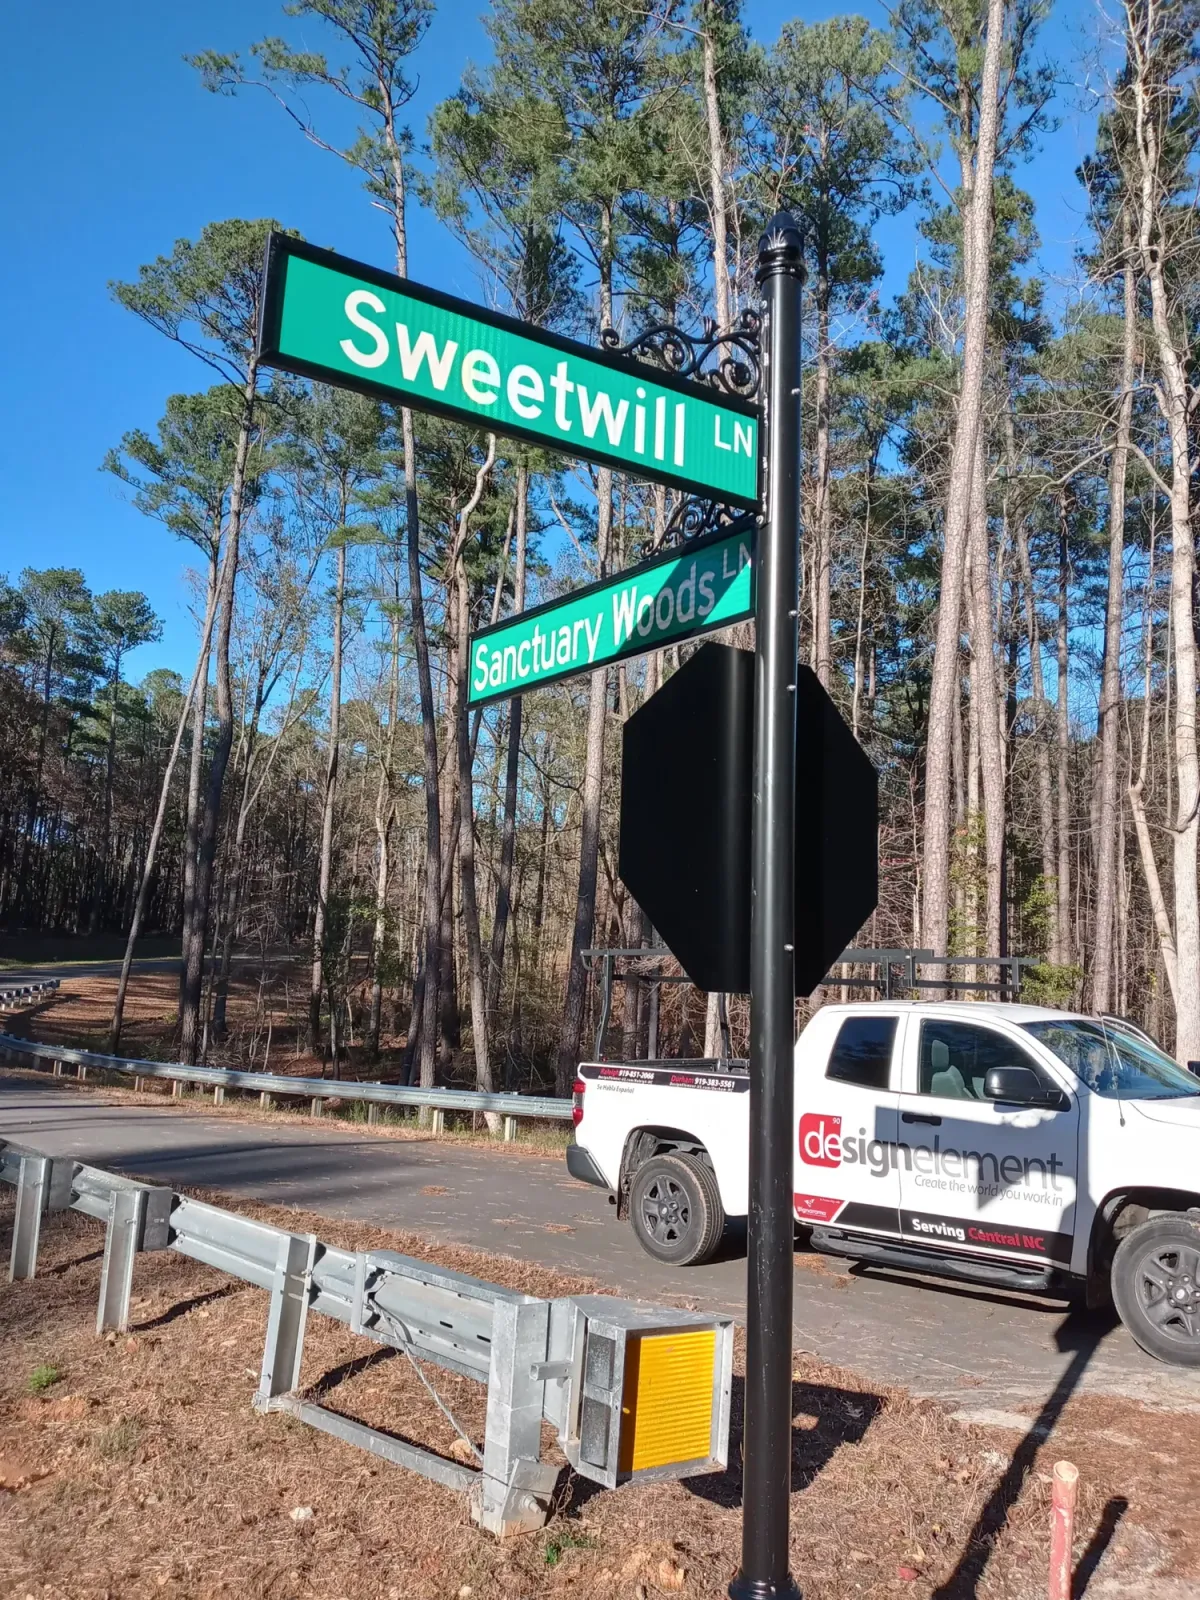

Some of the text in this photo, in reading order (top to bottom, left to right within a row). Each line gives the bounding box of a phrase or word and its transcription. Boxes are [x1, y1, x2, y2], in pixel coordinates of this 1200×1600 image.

[339, 289, 753, 467] Sweetwill LN
[473, 542, 752, 692] Sanctuary Woods LN
[671, 1074, 694, 1084] Durham
[694, 1077, 735, 1089] 919-383-5561
[832, 1117, 841, 1125] 90
[804, 1120, 1064, 1192] designelement
[914, 1174, 1063, 1207] Create the world you work in
[912, 1218, 1046, 1251] Serving Central NC
